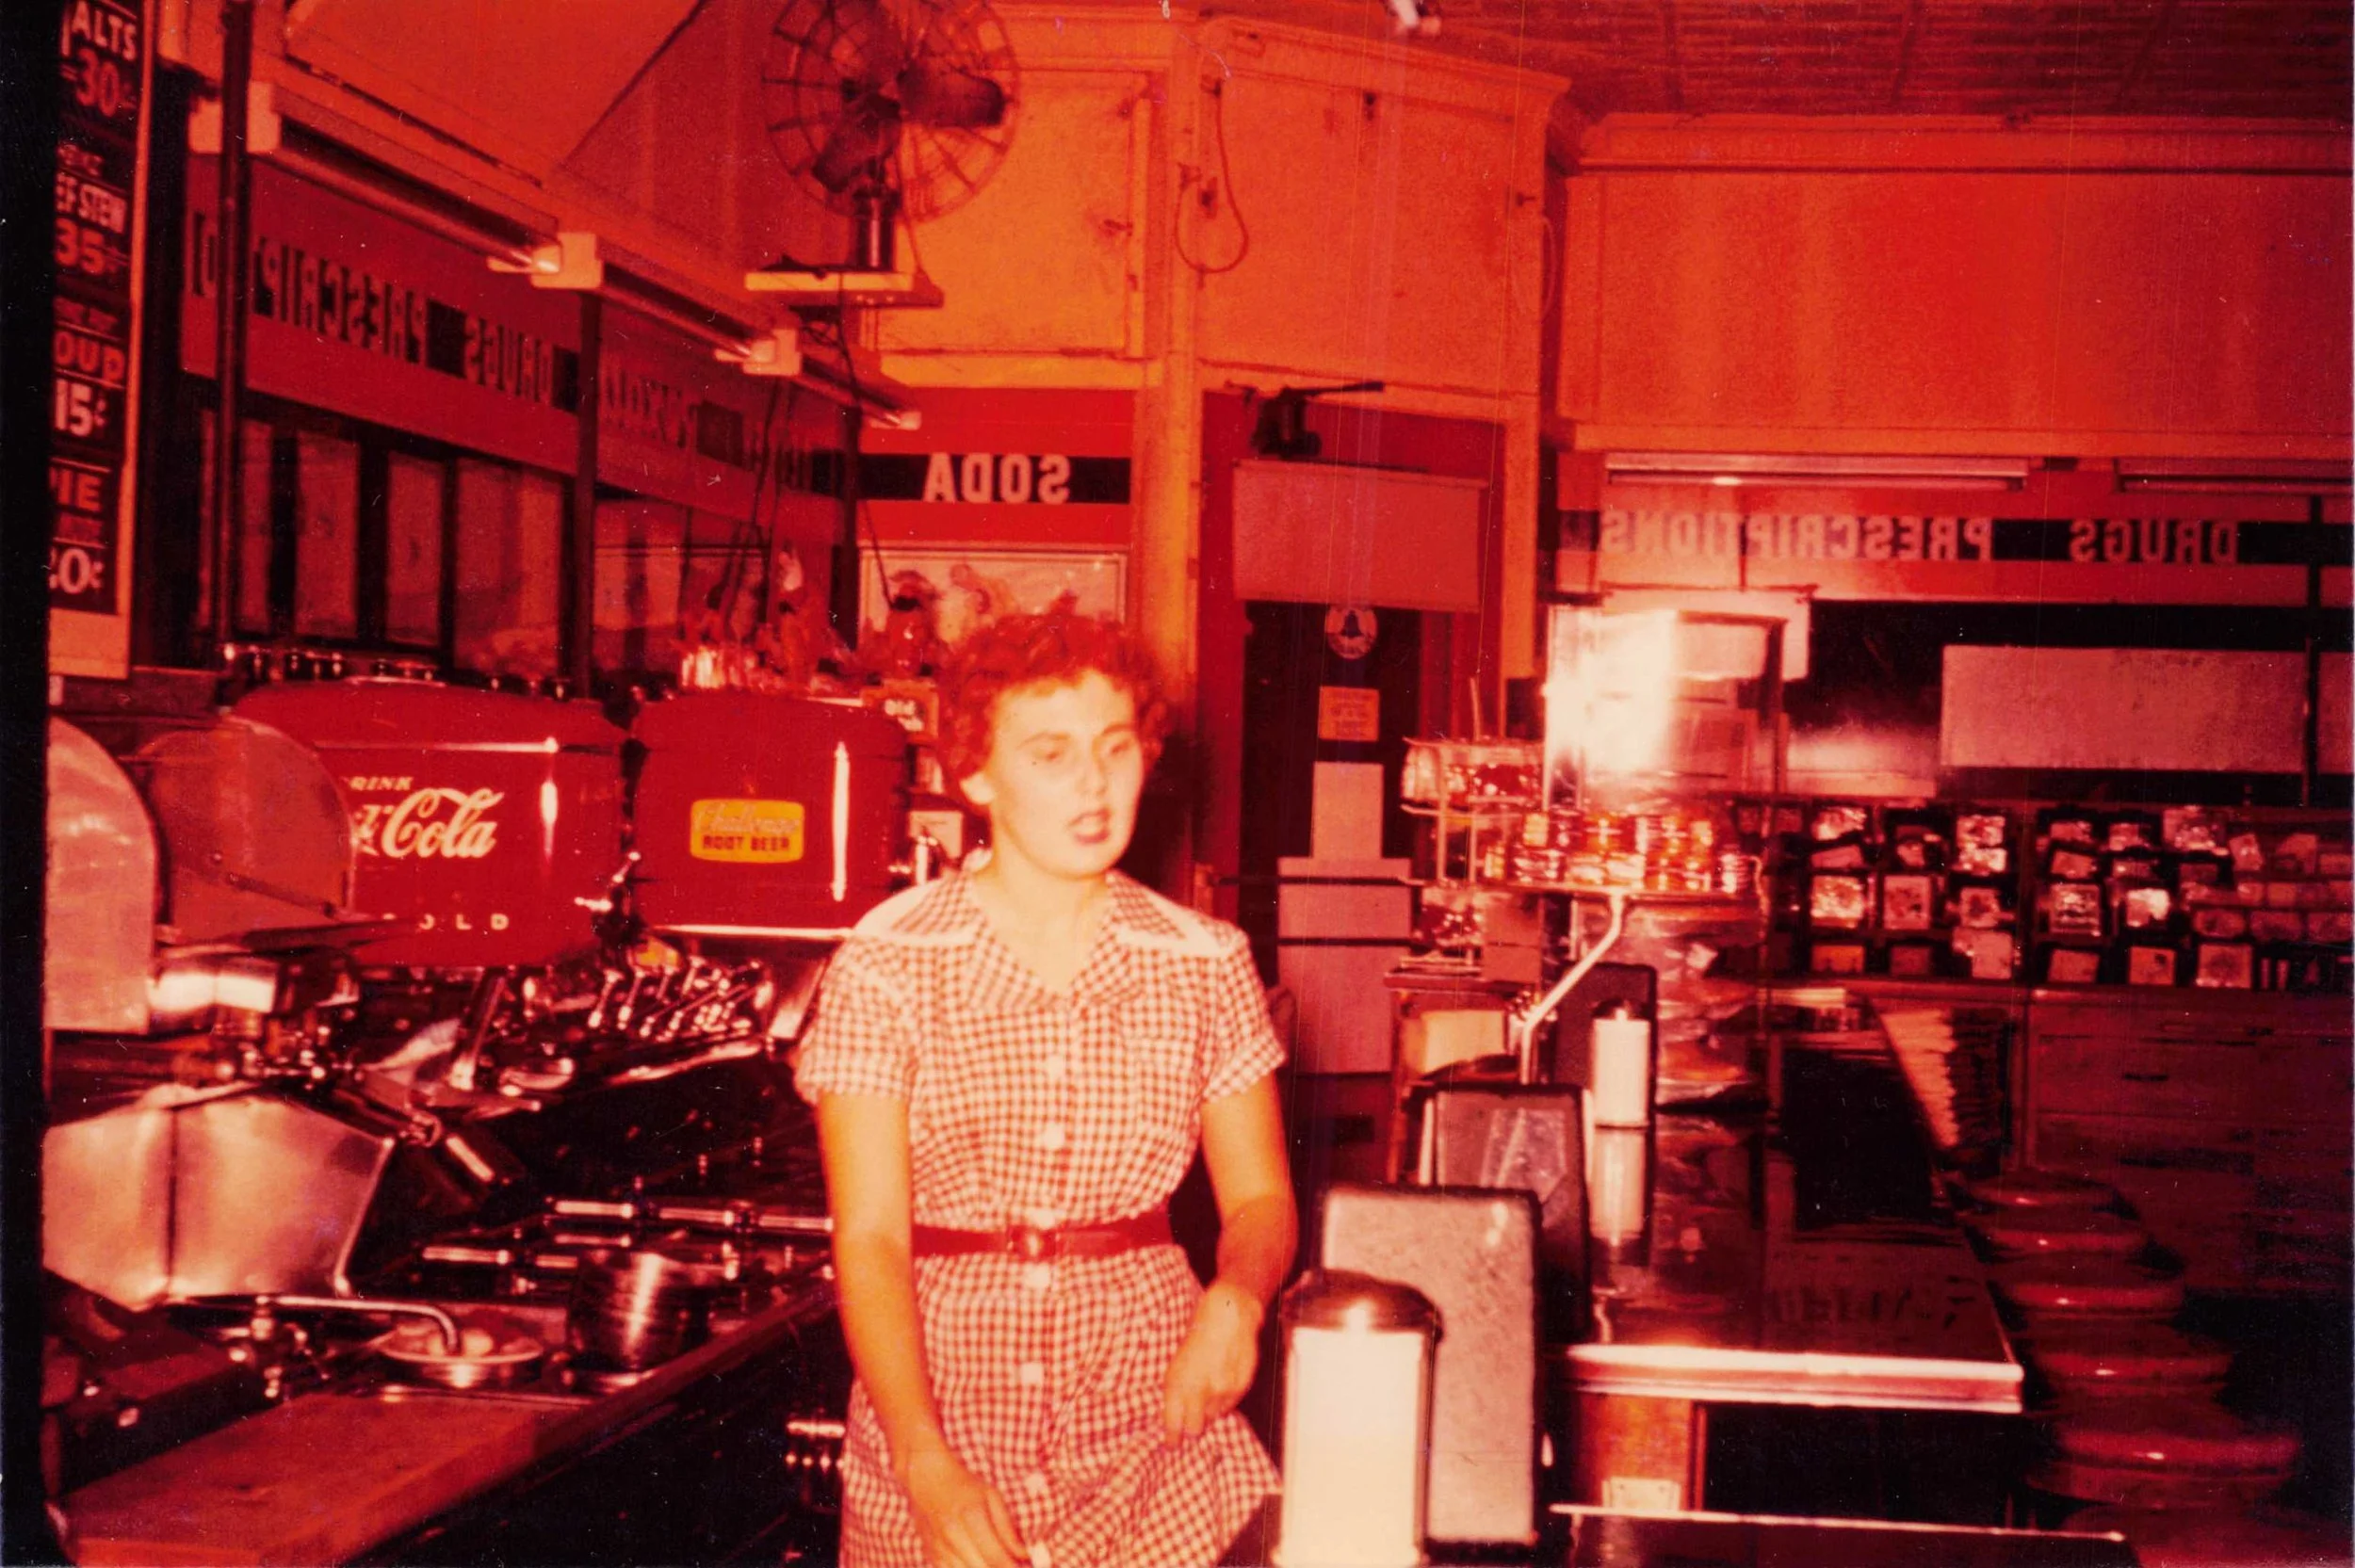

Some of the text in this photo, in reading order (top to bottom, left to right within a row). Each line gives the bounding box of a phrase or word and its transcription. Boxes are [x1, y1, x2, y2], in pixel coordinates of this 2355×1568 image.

[53, 329, 126, 382] OUP
[349, 776, 414, 791] RINK
[702, 835, 790, 851] ROOT BEER
